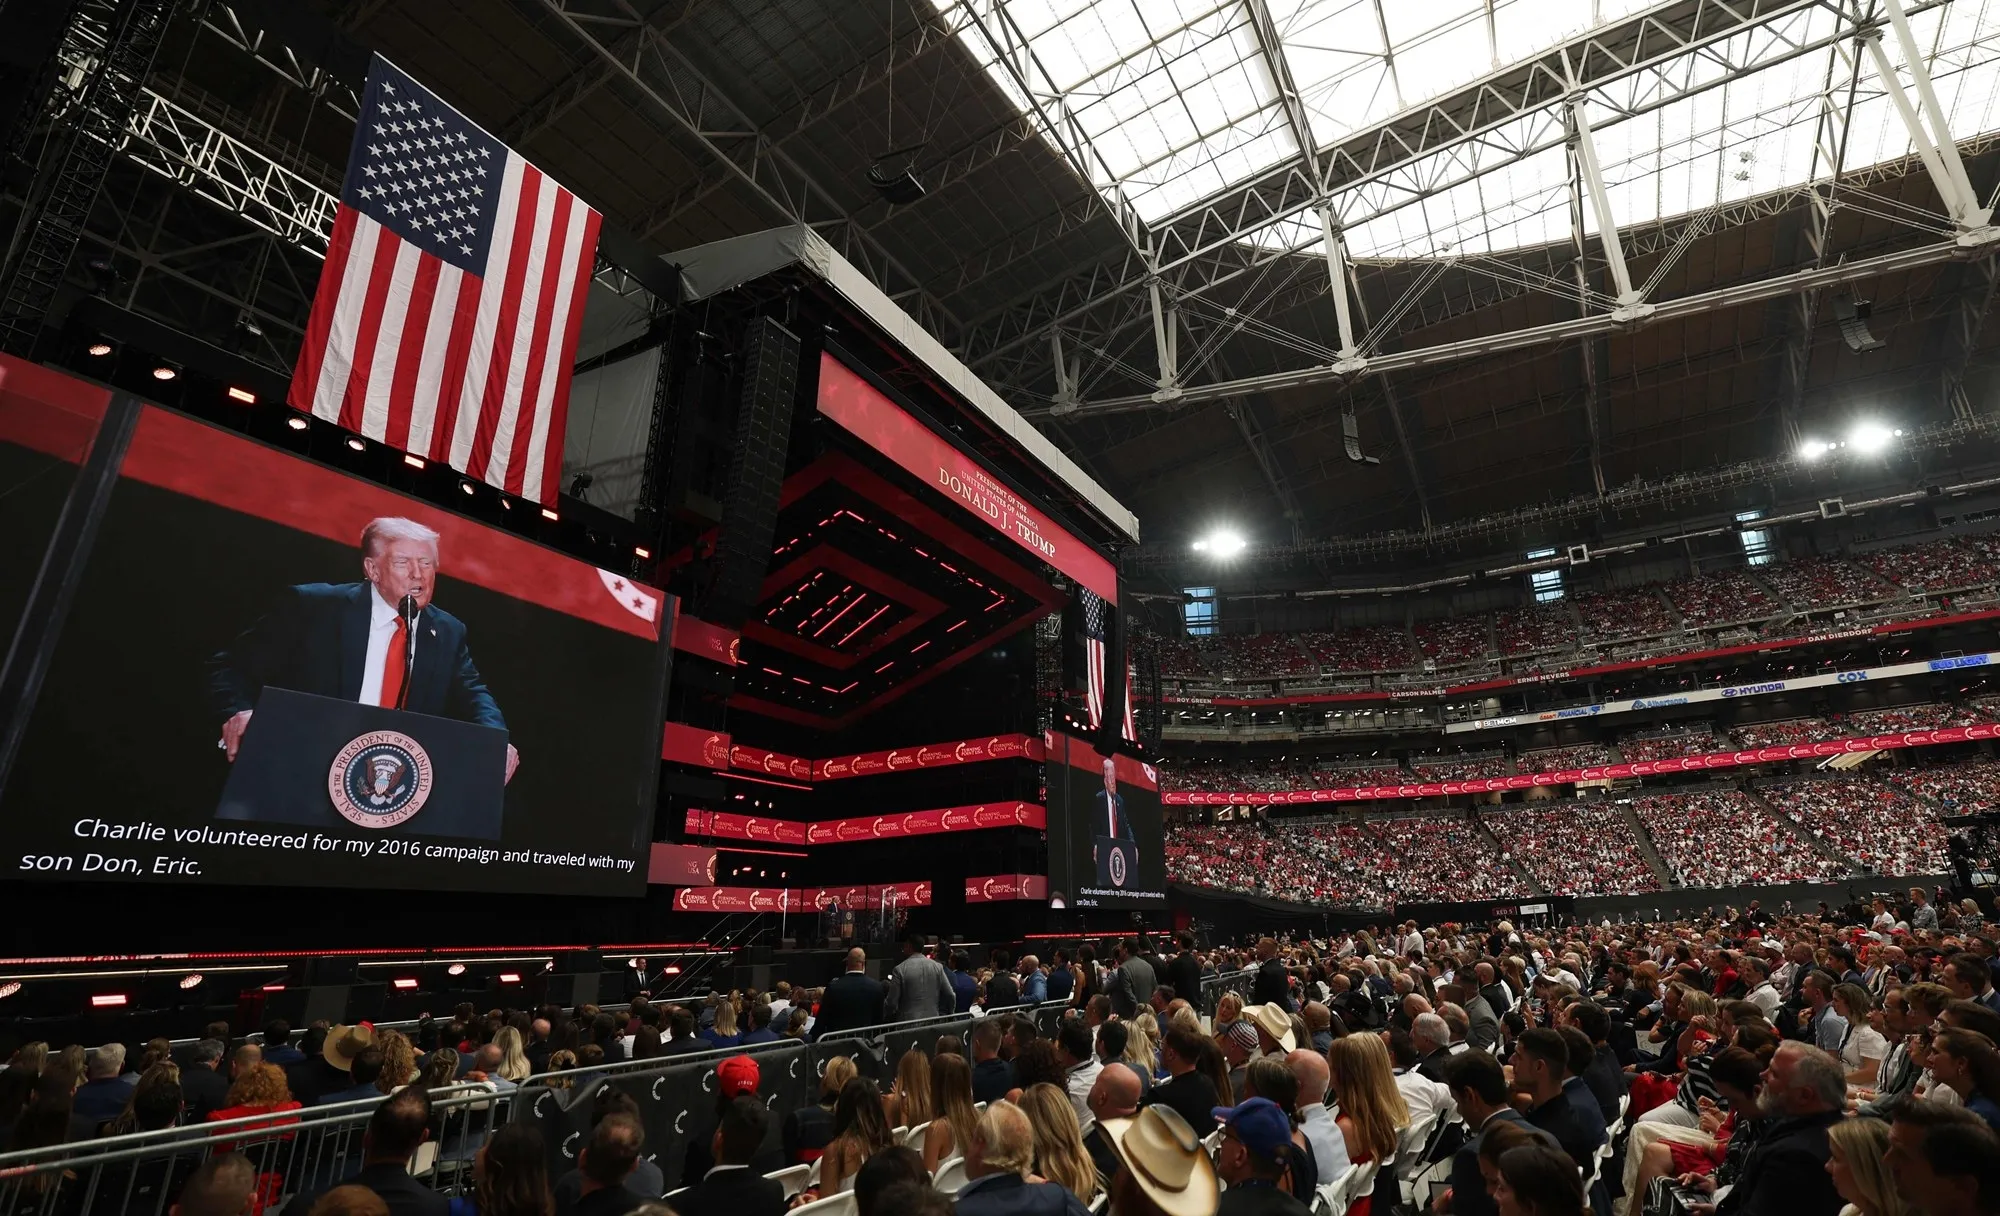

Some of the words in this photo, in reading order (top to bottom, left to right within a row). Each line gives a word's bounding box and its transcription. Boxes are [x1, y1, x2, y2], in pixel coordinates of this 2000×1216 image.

[962, 470, 984, 492] UNITED
[986, 488, 1006, 508] STATES
[1007, 504, 1015, 513] OF
[1016, 510, 1039, 531] AMERICA
[976, 471, 1007, 498] PRESIDENT
[1008, 494, 1016, 504] OF
[1016, 500, 1027, 513] THE
[939, 467, 998, 519] DONALD
[1001, 512, 1012, 529] J.
[1016, 520, 1056, 558] TRUMP
[1828, 628, 1872, 639] DIERDORF
[1930, 660, 1954, 670] BUD
[1955, 654, 1988, 667] LIGHT
[1540, 672, 1570, 680] NEVERS
[1838, 670, 1868, 682] COX
[1740, 682, 1785, 694] HYUNDAI
[1558, 708, 1588, 718] FINANCIAL
[336, 734, 391, 770] PRESIDENT
[403, 741, 414, 752] THE
[415, 752, 429, 792] UNITED
[340, 797, 364, 821] SEAL
[382, 798, 420, 824] STATES
[74, 818, 166, 841] Charlie
[174, 826, 307, 849] volunteered
[313, 834, 341, 851] for
[346, 841, 375, 856] my
[378, 840, 421, 856] 2016
[425, 845, 498, 864] campaign
[503, 850, 530, 863] and
[534, 852, 586, 867] traveled
[589, 856, 614, 868] with
[617, 860, 636, 873] my
[20, 854, 73, 871] son
[82, 854, 143, 876] Don,
[152, 856, 202, 875] Eric.
